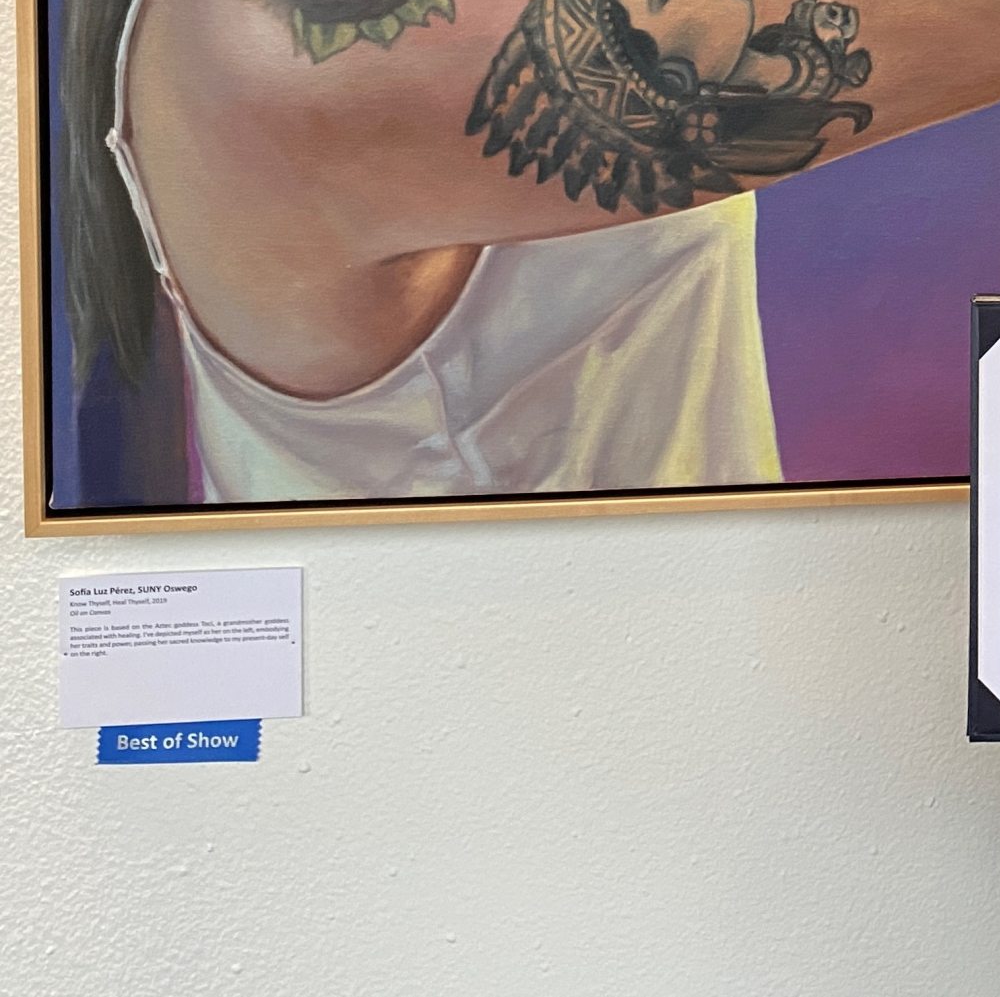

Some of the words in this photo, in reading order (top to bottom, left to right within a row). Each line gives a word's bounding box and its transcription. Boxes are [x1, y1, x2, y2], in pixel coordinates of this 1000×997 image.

[93, 587, 108, 595] Luz
[110, 586, 135, 595] Pérez,
[137, 585, 162, 593] SUNY
[164, 584, 197, 593] Oswego
[117, 735, 158, 750] Best
[163, 732, 184, 749] of
[186, 732, 239, 748] Show
